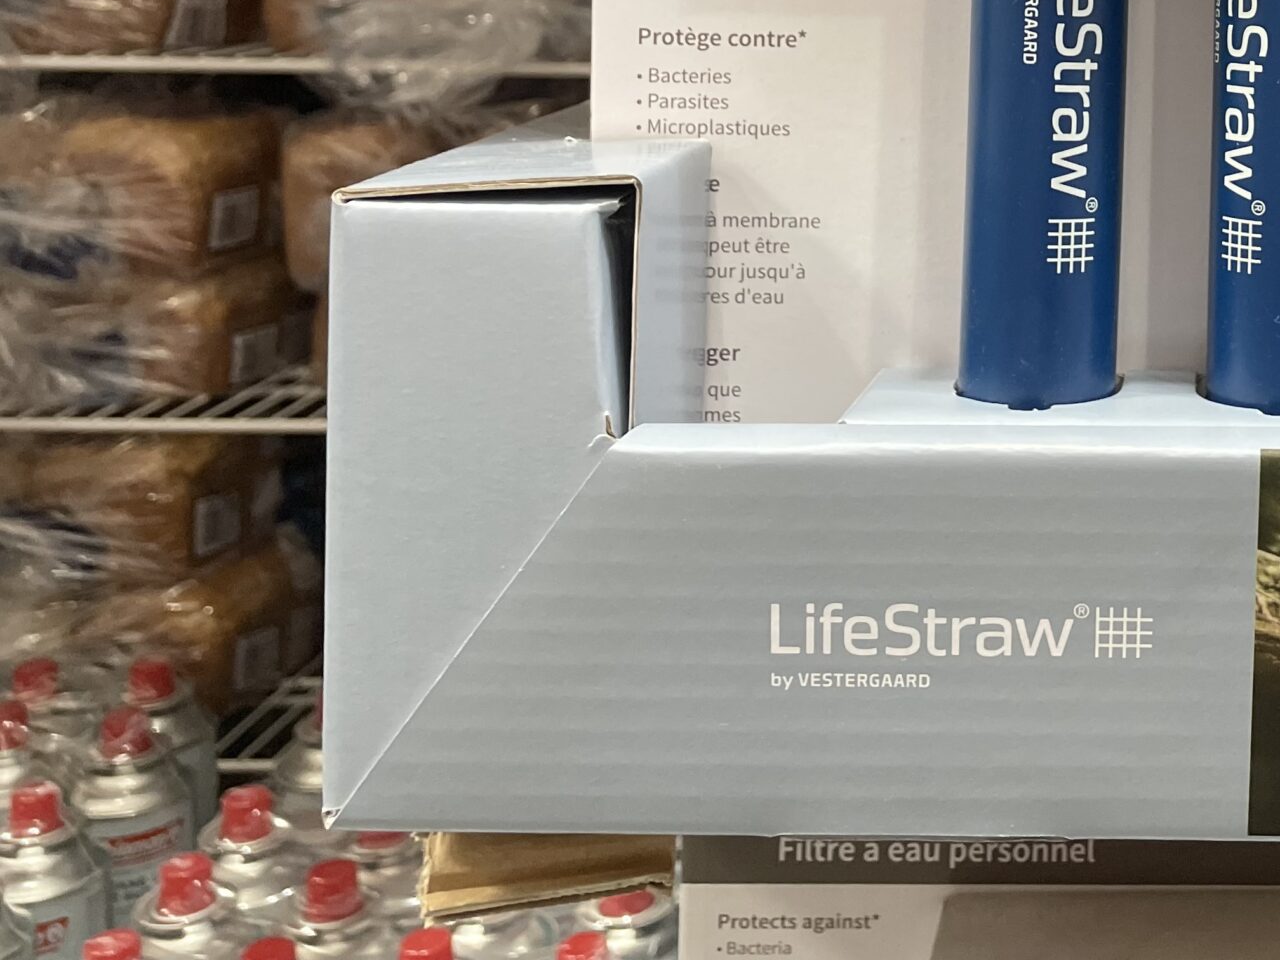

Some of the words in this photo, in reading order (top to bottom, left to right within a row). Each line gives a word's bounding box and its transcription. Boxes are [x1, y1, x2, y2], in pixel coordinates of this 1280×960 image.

[638, 26, 722, 51] Protège
[648, 67, 732, 85] Bacteries
[647, 93, 729, 111] Parasites
[647, 118, 790, 139] Microplastiques
[722, 212, 821, 229] membrane
[709, 238, 750, 257] peut
[755, 237, 790, 254] être
[739, 263, 806, 283] jusqu'à
[735, 288, 784, 304] d'eau
[707, 385, 742, 401] que
[771, 672, 794, 691] by
[798, 672, 931, 689] VESTERGAARD
[778, 836, 855, 862] Filtre
[887, 843, 940, 862] eau
[949, 840, 1096, 869] personnel
[718, 913, 797, 931] Protects
[727, 940, 792, 957] Bacteria
